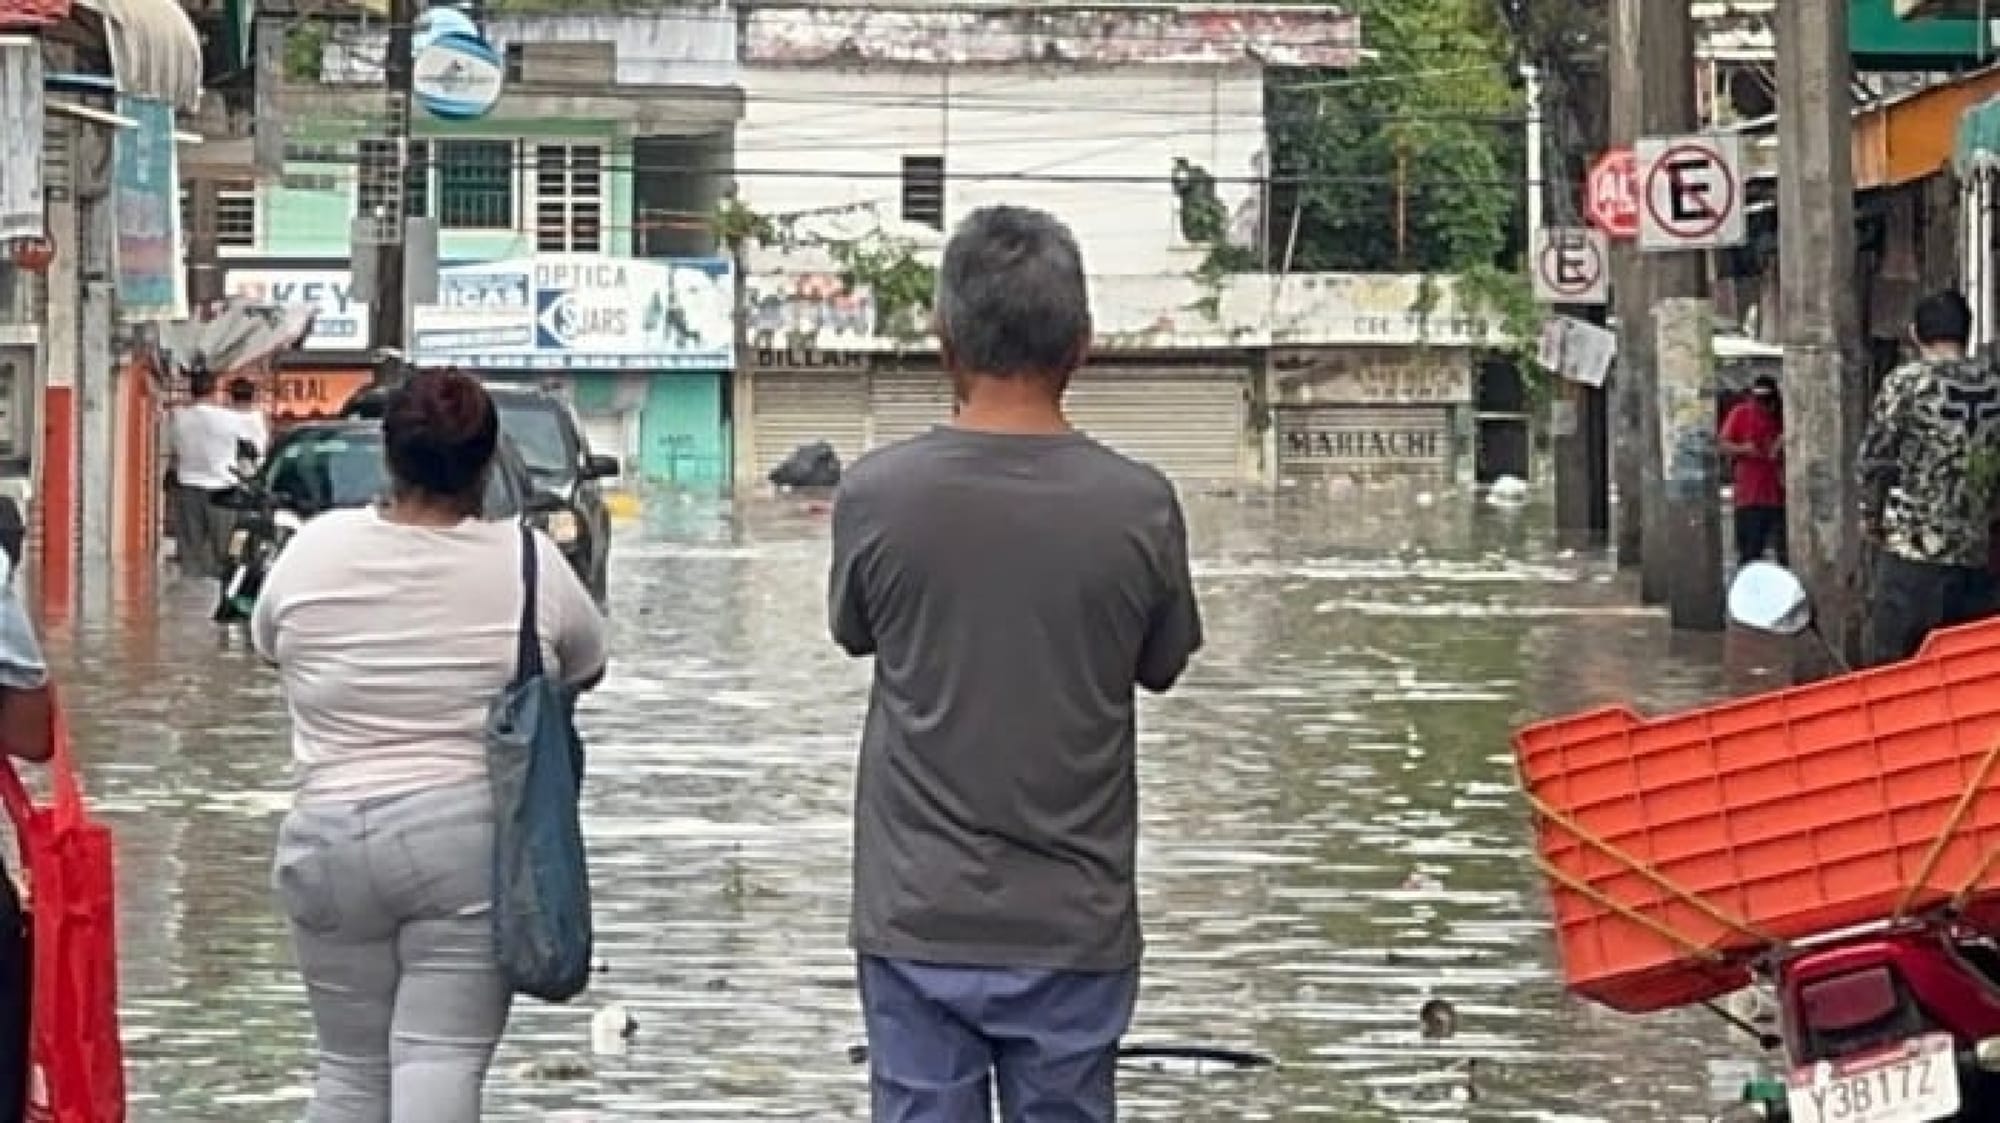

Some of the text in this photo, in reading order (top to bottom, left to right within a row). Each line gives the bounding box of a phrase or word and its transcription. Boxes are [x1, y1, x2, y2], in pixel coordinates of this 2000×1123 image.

[1667, 159, 1710, 220] E
[535, 264, 628, 288] OPTICA
[1556, 243, 1587, 283] E
